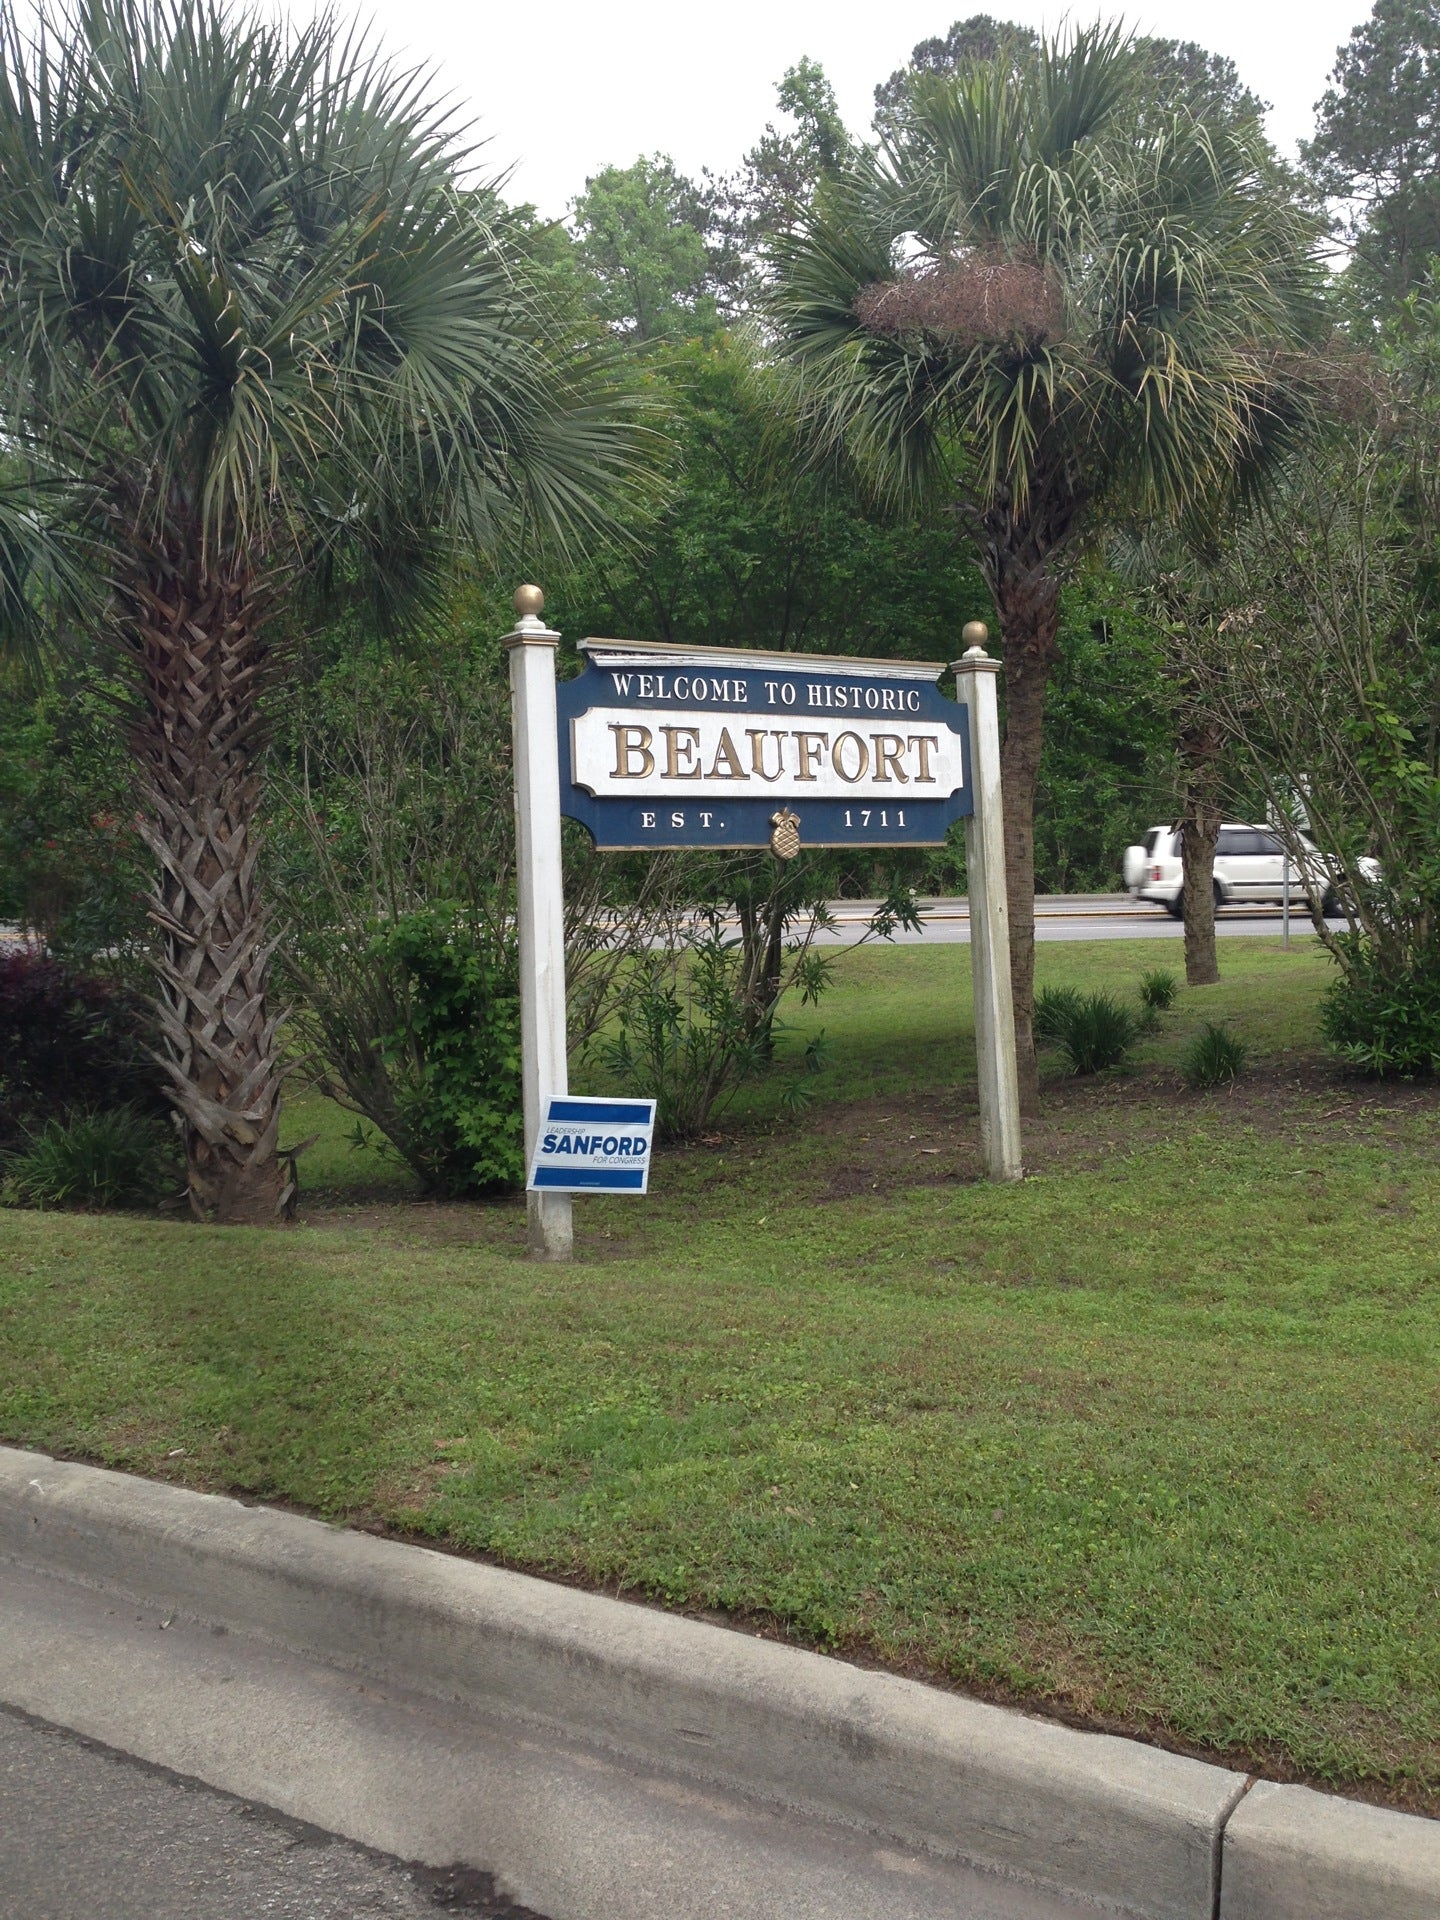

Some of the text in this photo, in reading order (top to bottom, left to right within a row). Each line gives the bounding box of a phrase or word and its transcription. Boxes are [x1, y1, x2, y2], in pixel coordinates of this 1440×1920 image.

[611, 673, 920, 712] WELCOME TO HISTORIC
[607, 724, 939, 784] BEAUFORT
[844, 810, 907, 828] 1711
[541, 1134, 648, 1156] SANFORD
[592, 1156, 646, 1164] FOR CONGRESS
